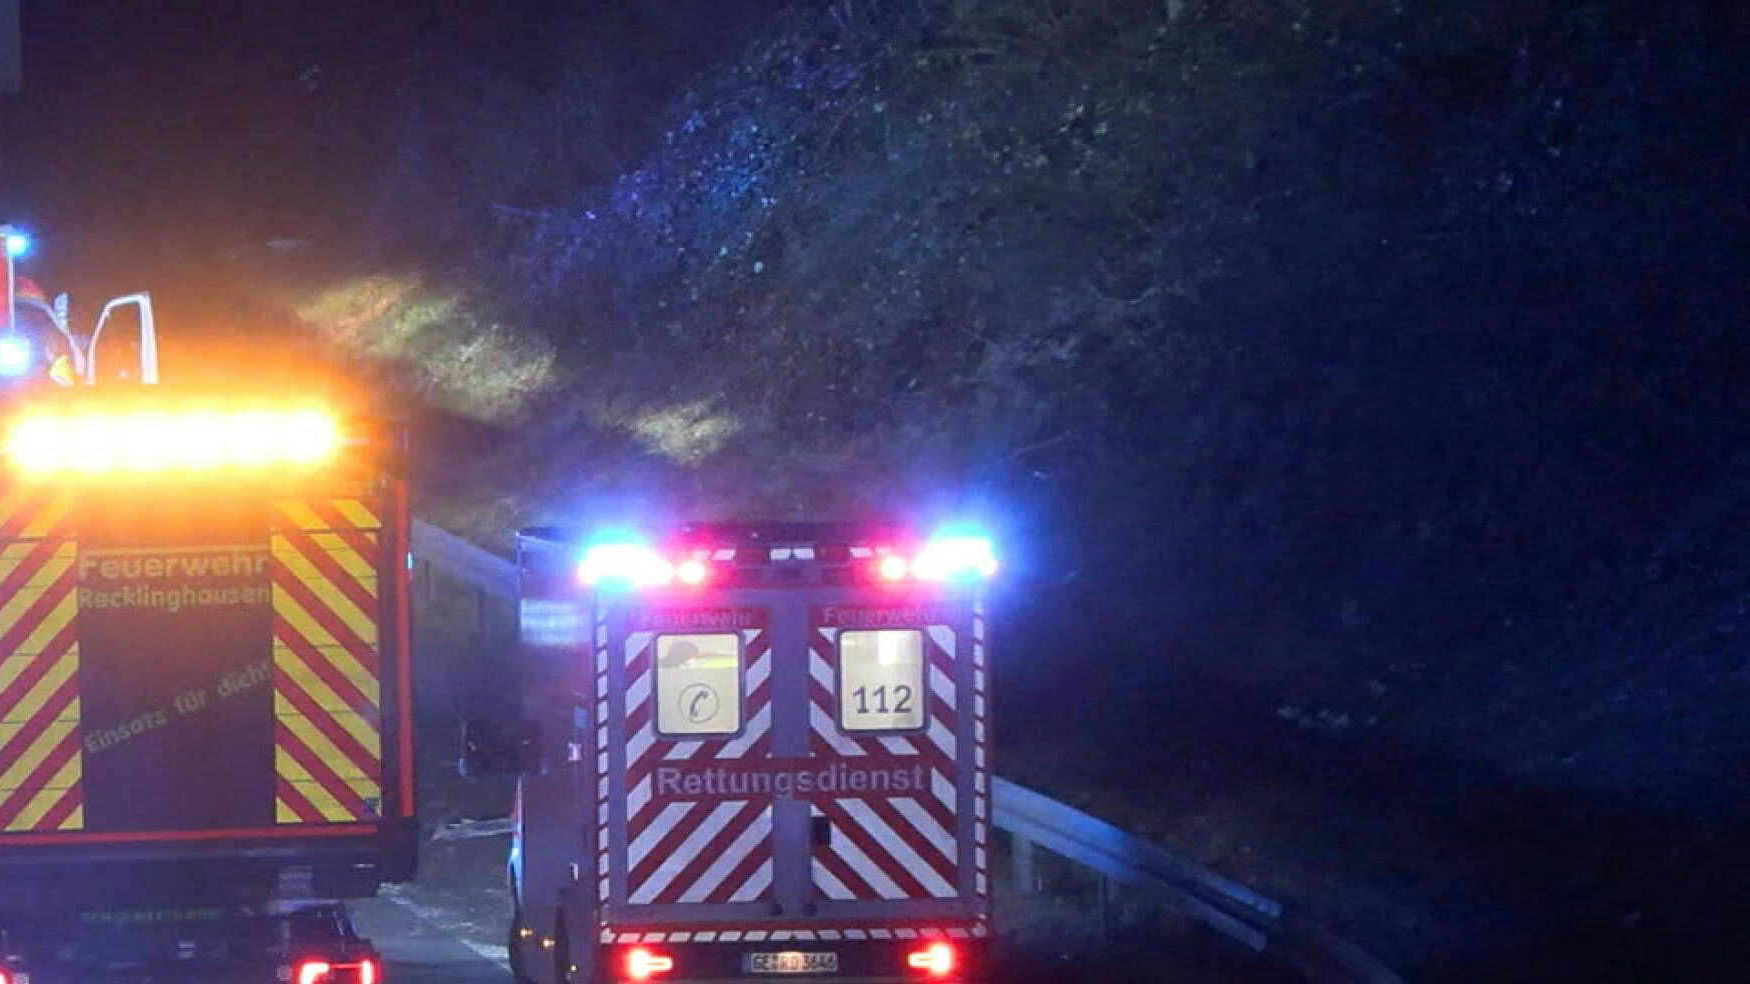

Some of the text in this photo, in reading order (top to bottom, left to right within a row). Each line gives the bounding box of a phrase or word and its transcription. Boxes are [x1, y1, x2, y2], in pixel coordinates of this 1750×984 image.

[79, 552, 268, 580] Feuerwehr
[79, 585, 270, 612] Recklinghausen
[853, 684, 912, 713] 112
[84, 709, 168, 753] Einsatz
[174, 688, 208, 715] für
[657, 763, 925, 799] Rettungsdienst
